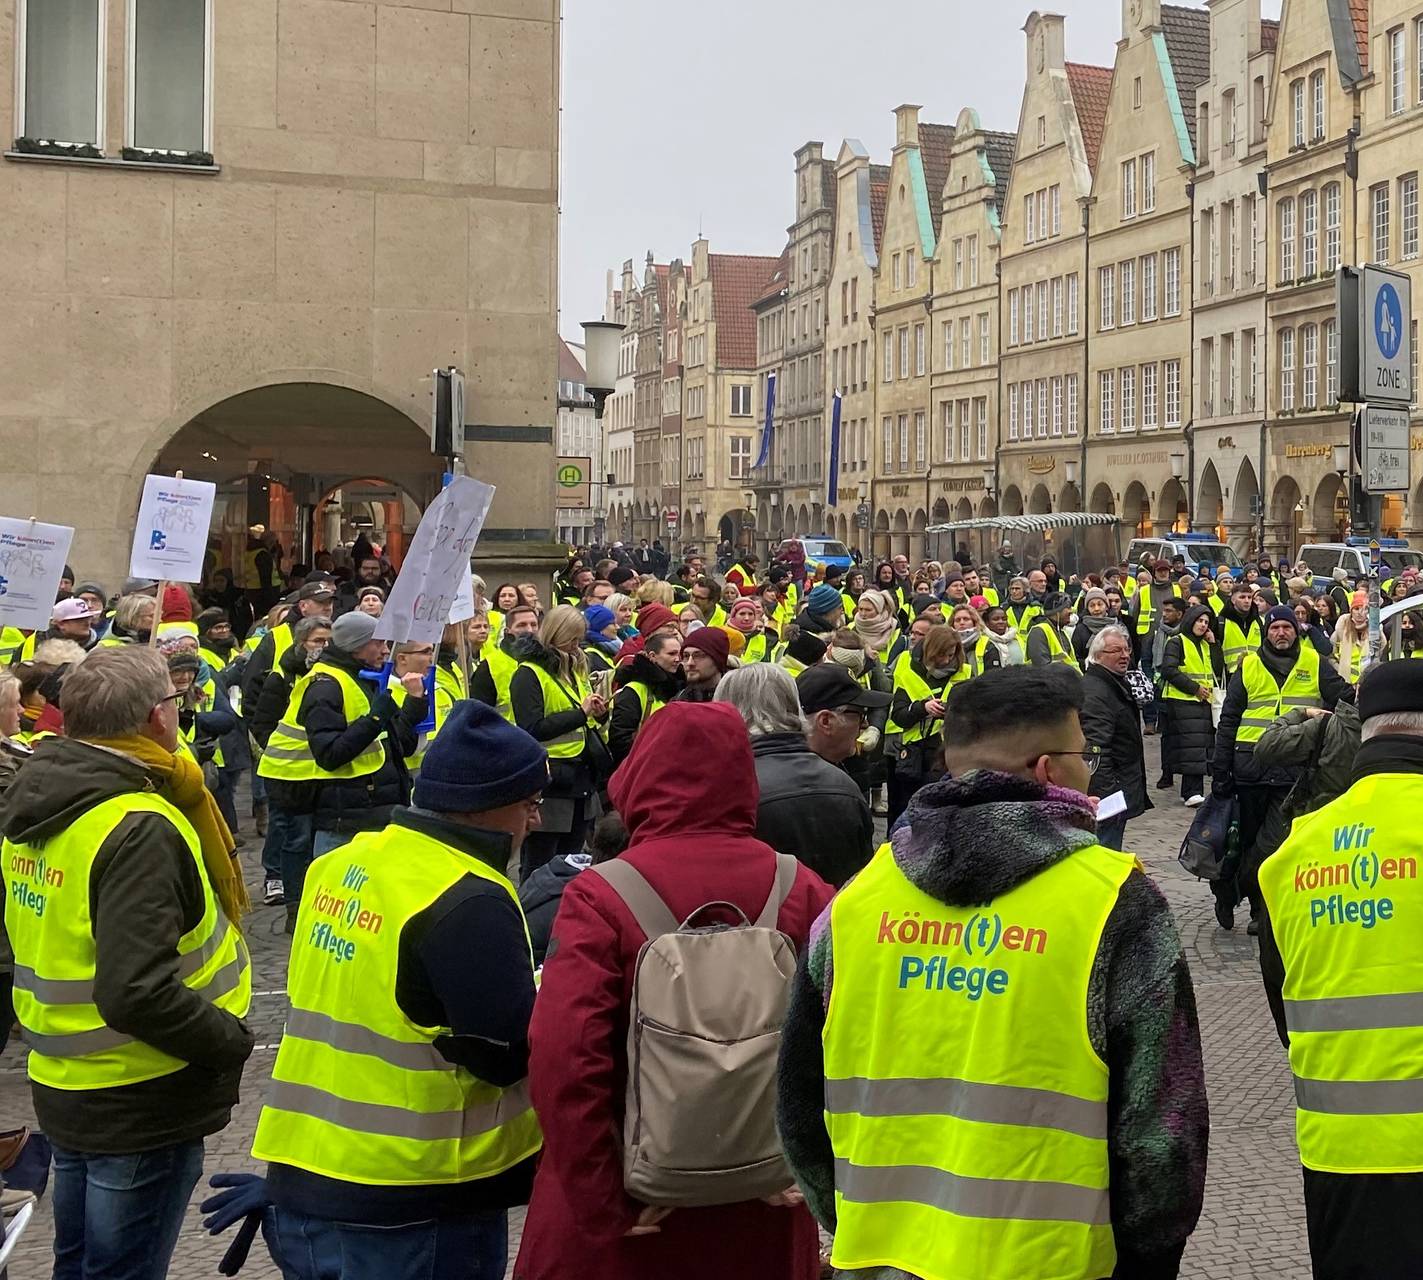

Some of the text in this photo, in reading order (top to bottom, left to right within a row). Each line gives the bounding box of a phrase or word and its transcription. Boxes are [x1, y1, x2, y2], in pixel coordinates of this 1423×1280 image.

[1376, 366, 1400, 389] ZONE
[564, 470, 576, 481] H
[1333, 822, 1376, 852] Wir
[11, 850, 65, 888] önn(t)en
[342, 863, 370, 893] Wir
[1294, 851, 1418, 893] könn(t)en
[12, 880, 47, 917] Pfleg
[311, 885, 384, 935] könn(t)en
[1310, 894, 1394, 929] Pflege
[309, 921, 356, 963] Pflege
[877, 901, 1048, 957] könn(t)en
[898, 955, 1009, 1001] Pflege
